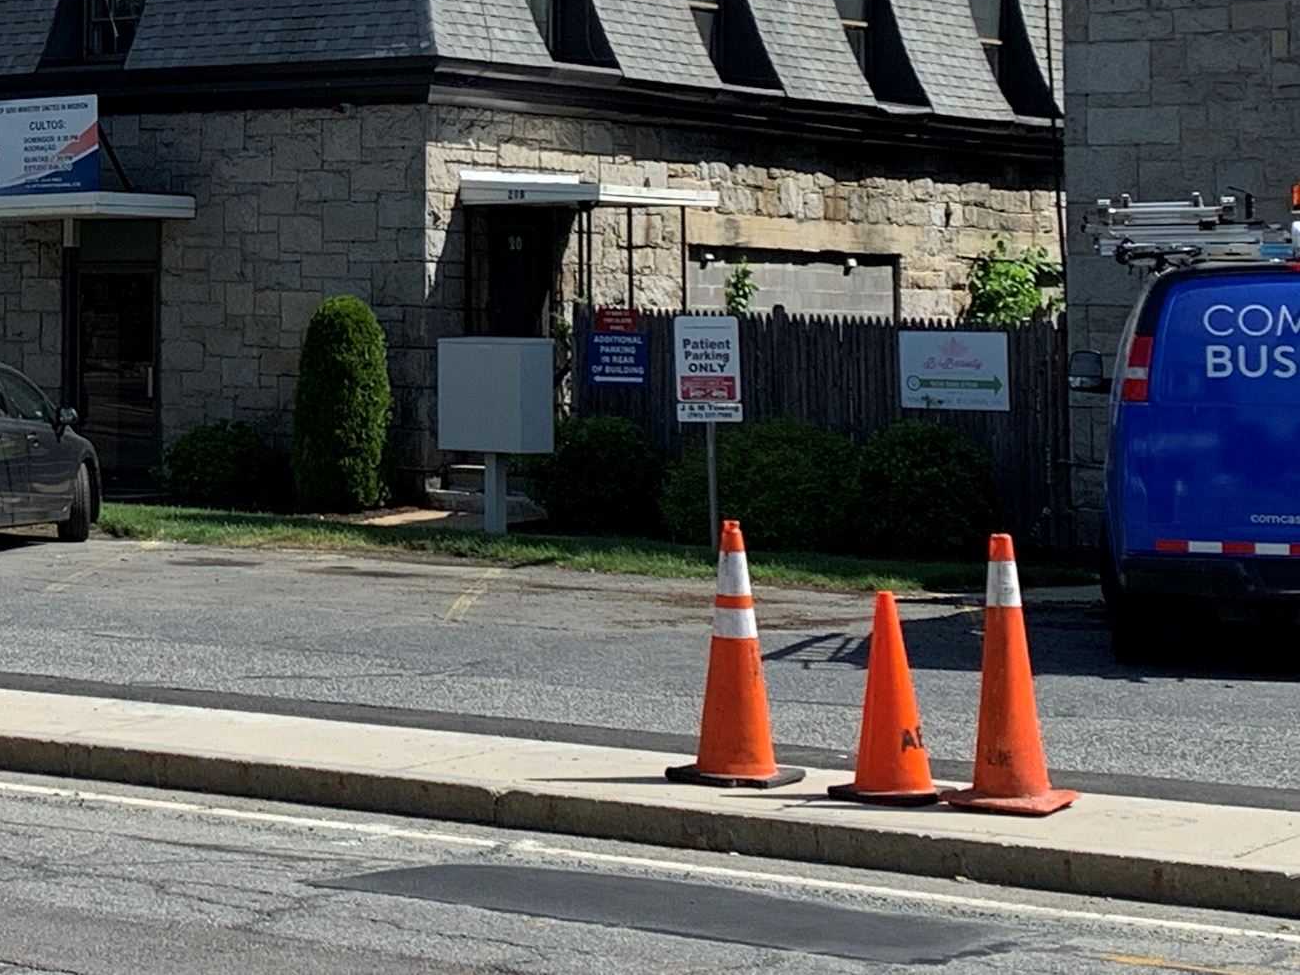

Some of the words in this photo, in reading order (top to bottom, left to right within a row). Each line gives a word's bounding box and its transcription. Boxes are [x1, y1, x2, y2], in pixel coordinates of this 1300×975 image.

[29, 120, 67, 131] CULTOS:
[508, 235, 522, 251] 20
[593, 335, 643, 344] ADDITIONAL
[683, 338, 731, 350] Patient
[599, 345, 636, 355] PARKING
[612, 355, 635, 364] REAR
[684, 351, 730, 362] Parking
[1206, 345, 1297, 378] BUS
[591, 365, 603, 373] OF
[604, 365, 644, 375] BUILDING
[688, 363, 726, 373] ONLY
